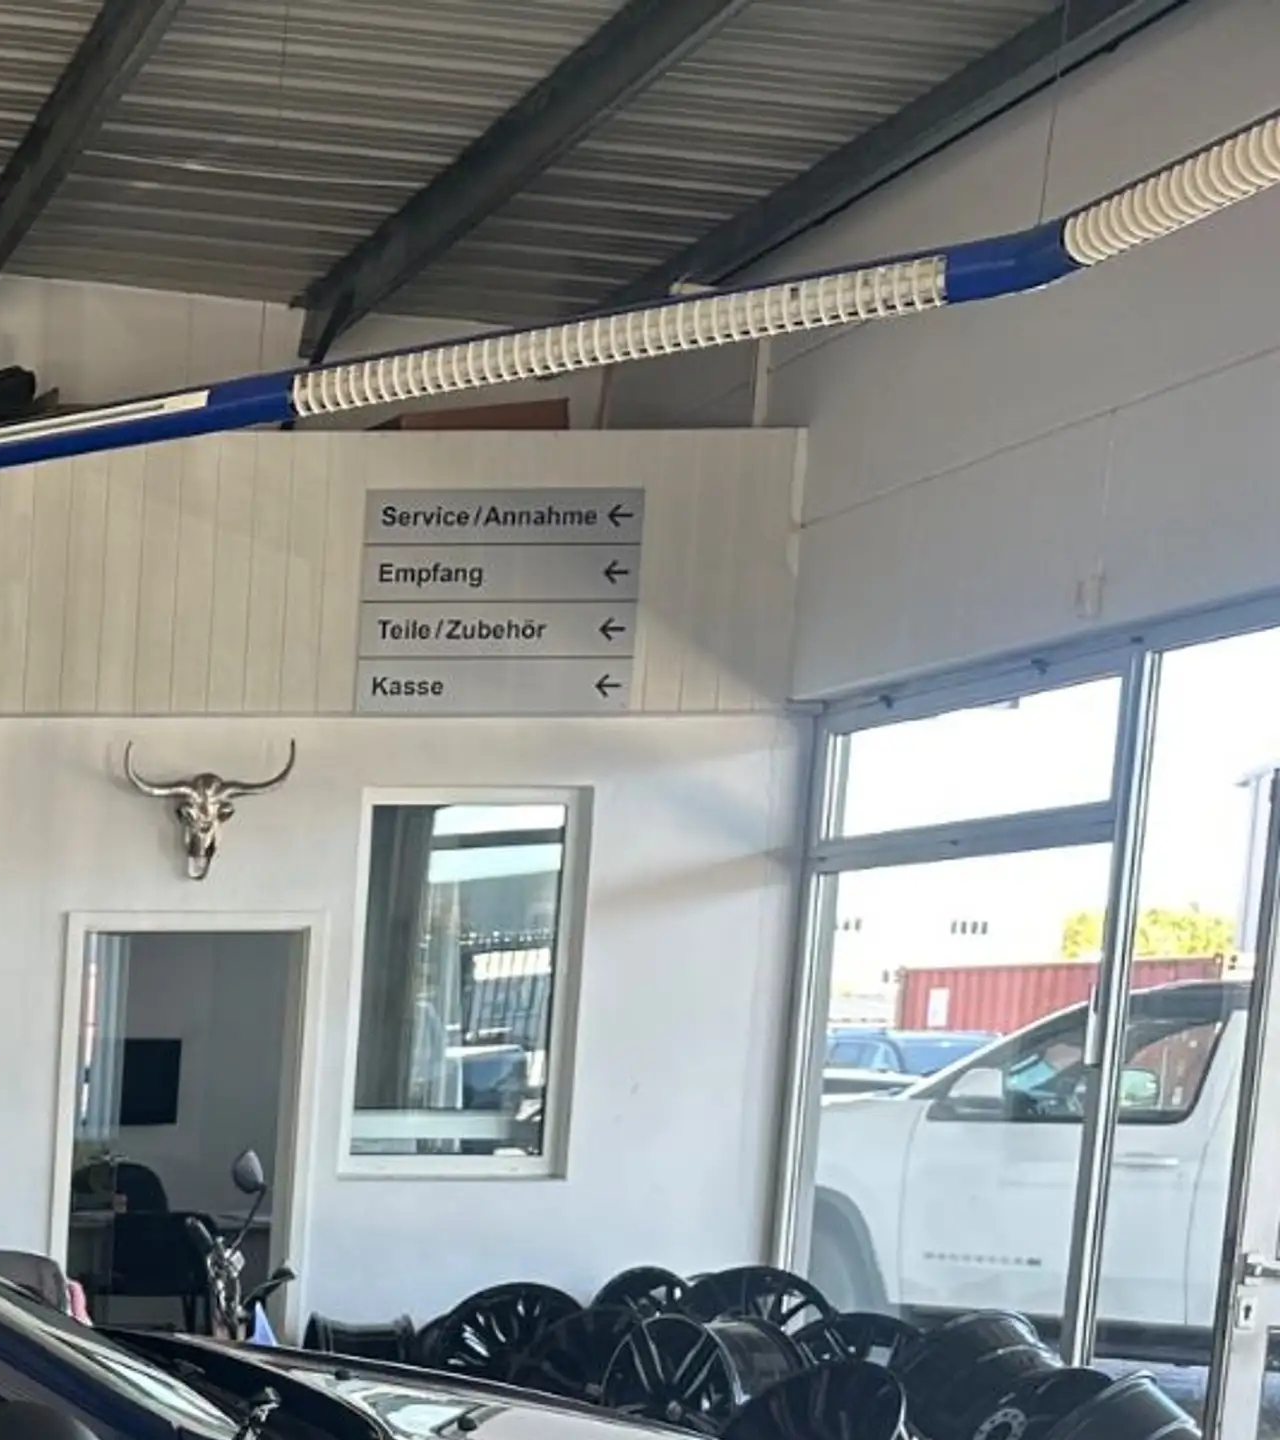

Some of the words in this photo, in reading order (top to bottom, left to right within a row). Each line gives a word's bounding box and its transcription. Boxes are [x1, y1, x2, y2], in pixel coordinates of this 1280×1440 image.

[381, 505, 598, 528] Service/Annahme
[378, 563, 484, 587] Empfang
[377, 618, 547, 641] Teile/Zubehör
[371, 676, 444, 697] Kasse
